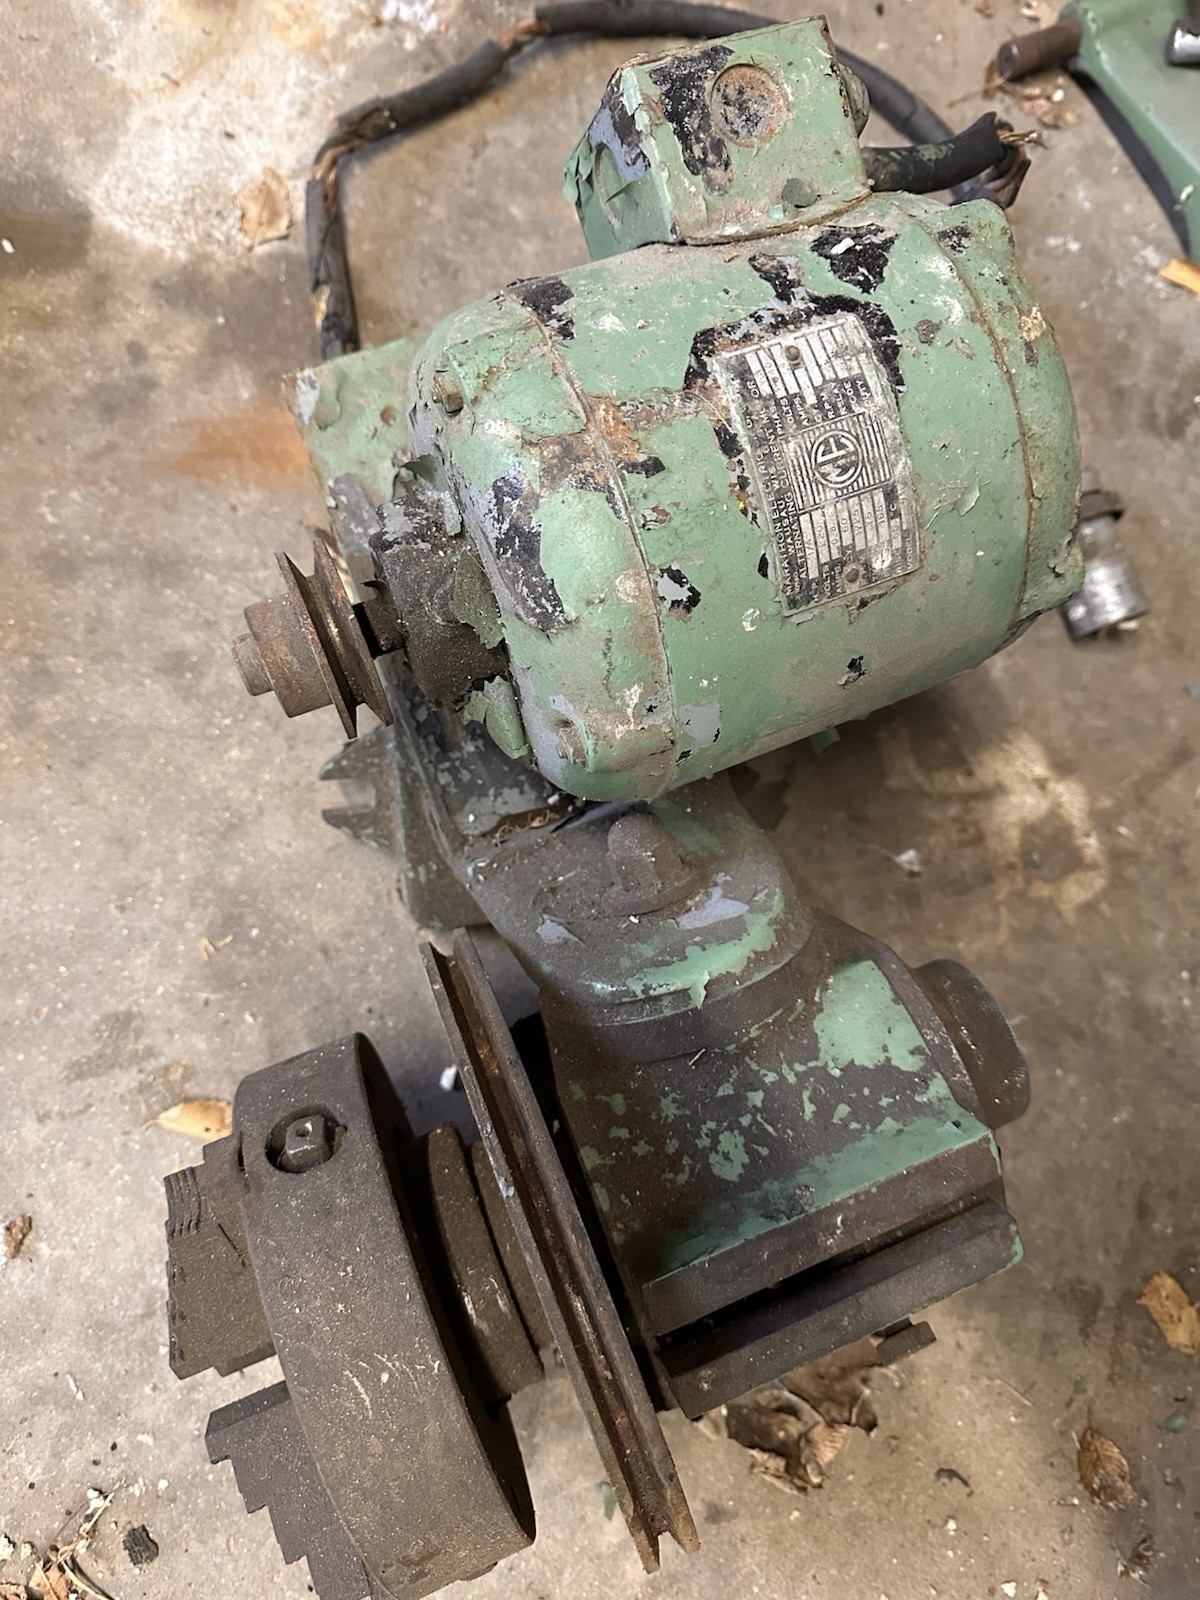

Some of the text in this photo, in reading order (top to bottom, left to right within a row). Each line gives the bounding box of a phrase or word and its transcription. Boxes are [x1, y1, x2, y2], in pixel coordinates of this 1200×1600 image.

[829, 379, 848, 415] RELAY
[843, 379, 860, 412] CODE
[855, 377, 872, 407] DUTY
[791, 393, 810, 427] AMPS.
[763, 426, 790, 489] CURRENT
[783, 491, 808, 580] ALTERNATING
[839, 516, 849, 533] 60
[850, 508, 863, 535] 1725
[772, 521, 793, 595] MARATHON
[820, 564, 831, 598] VOLTS
